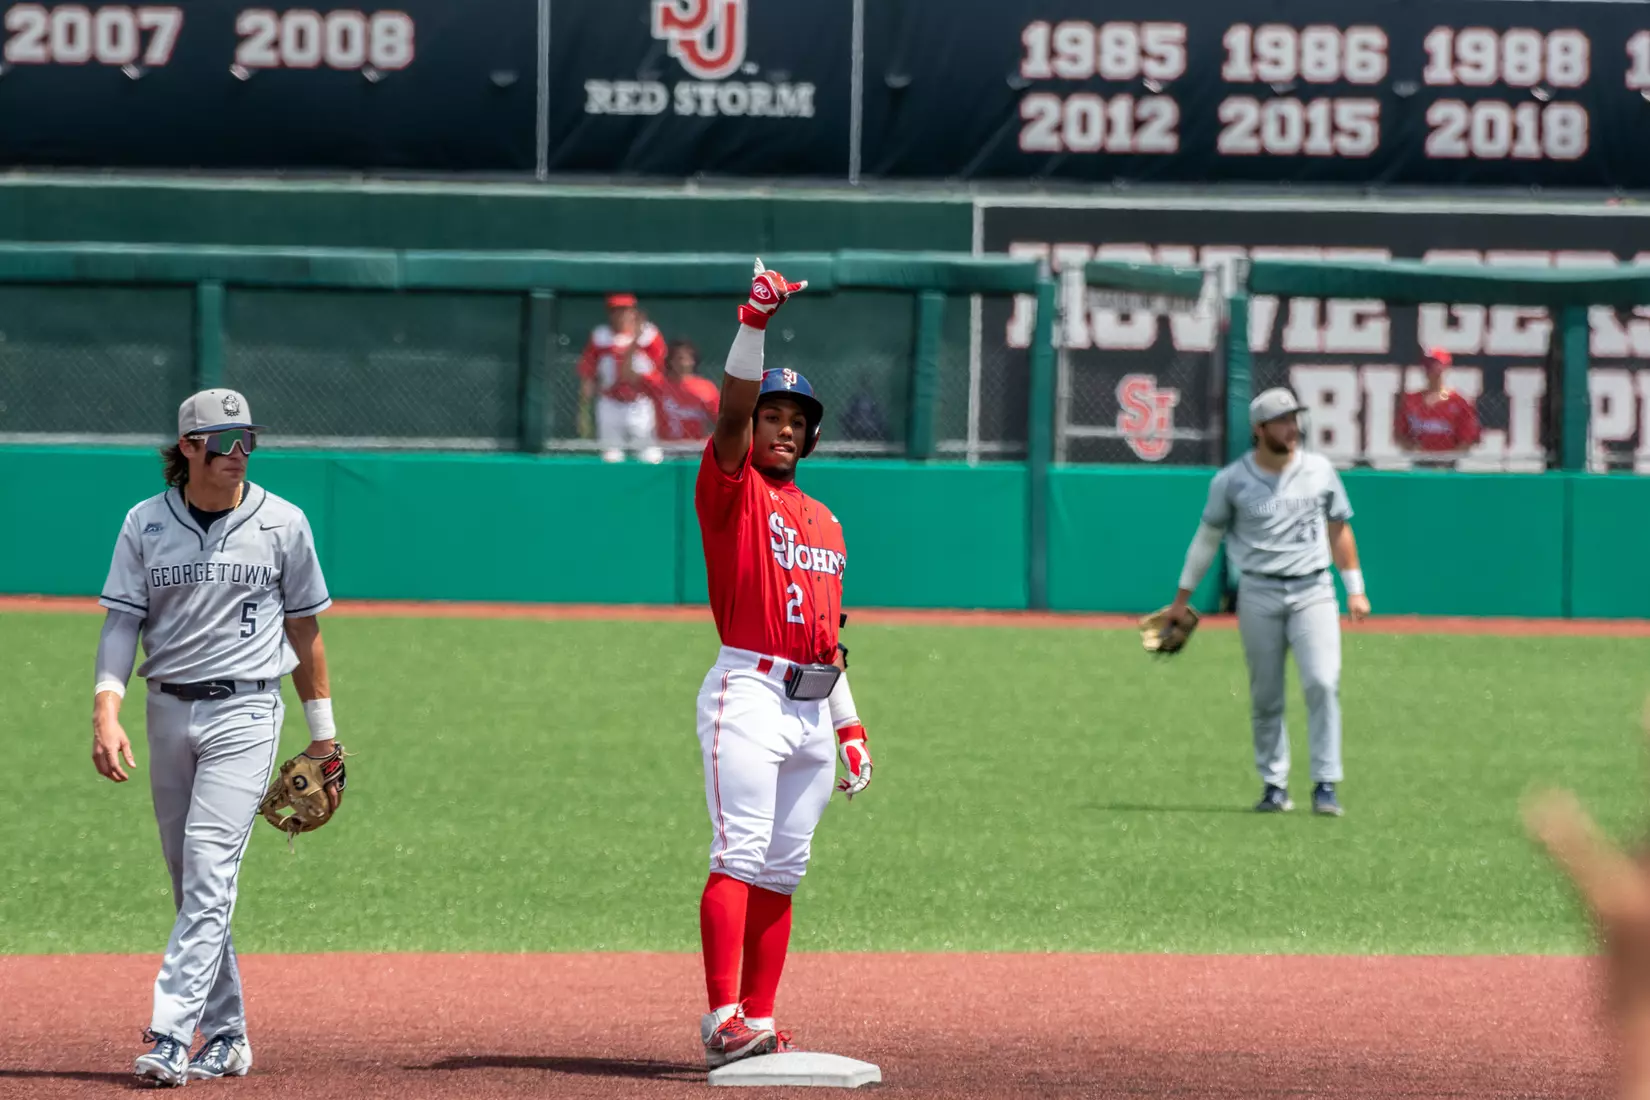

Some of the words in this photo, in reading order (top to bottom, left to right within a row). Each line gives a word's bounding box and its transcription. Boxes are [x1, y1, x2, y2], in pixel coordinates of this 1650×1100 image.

[4, 4, 183, 65] 2007
[235, 9, 416, 70] 2008
[1020, 21, 1188, 81] 1985
[1222, 23, 1390, 85] 1986
[1423, 26, 1591, 88] 1988
[584, 80, 669, 115] RED
[674, 82, 816, 118] STORM
[1019, 93, 1180, 153] 2012
[1217, 95, 1380, 156] 2015
[1425, 100, 1590, 159] 2018
[1289, 363, 1650, 473] BULLP
[150, 562, 273, 588] GEORGETOWN
[239, 601, 259, 639] 5
[785, 582, 805, 625] 2
